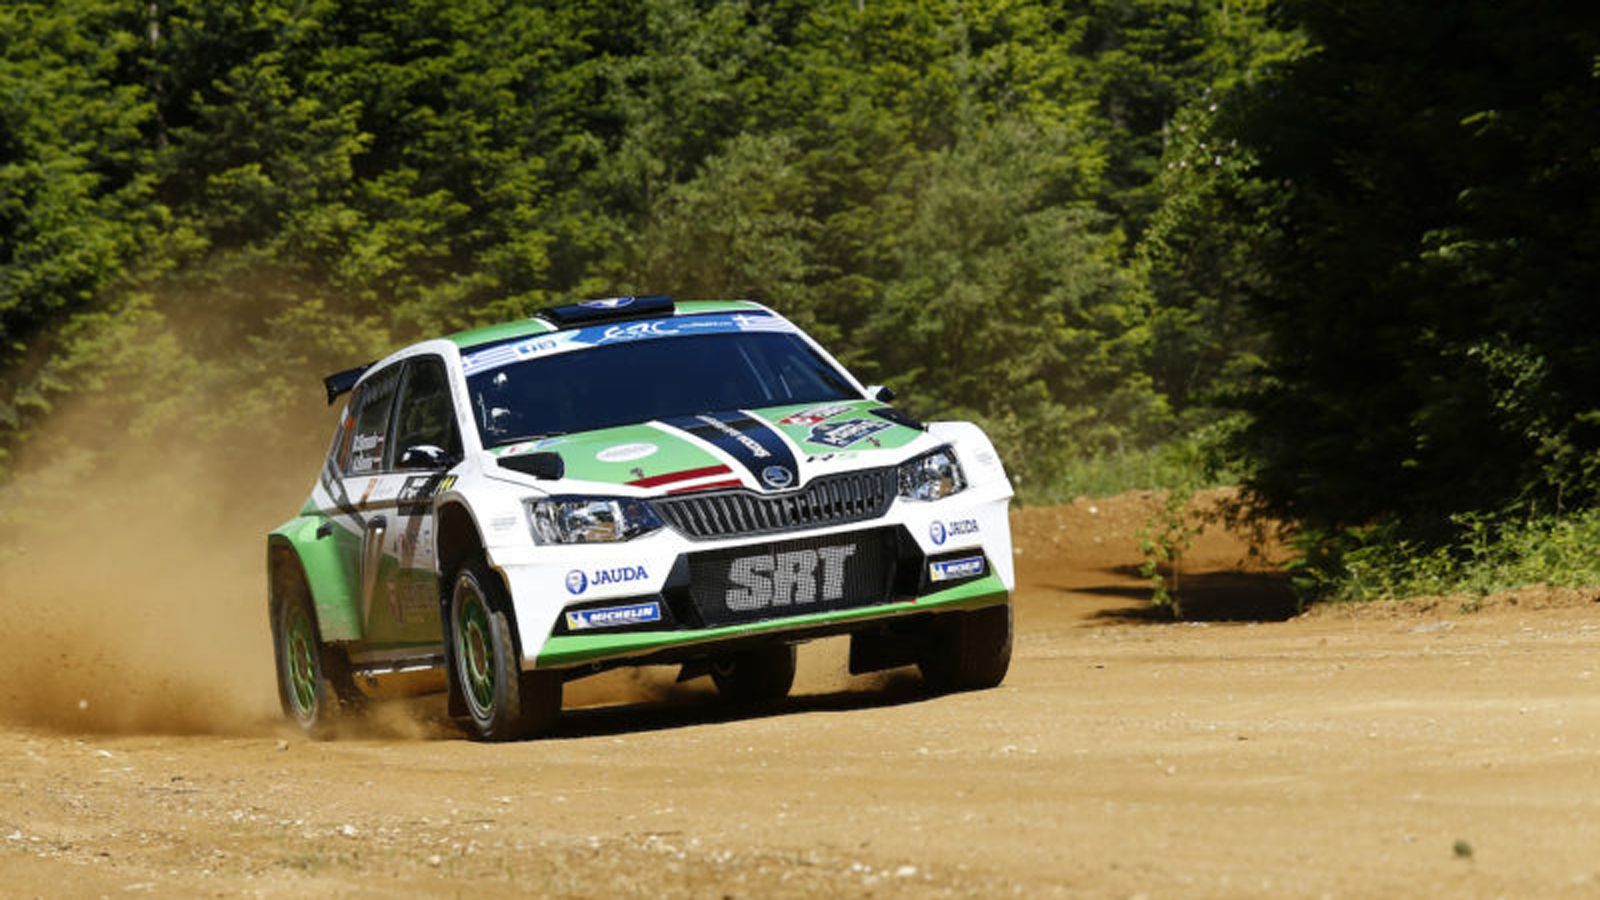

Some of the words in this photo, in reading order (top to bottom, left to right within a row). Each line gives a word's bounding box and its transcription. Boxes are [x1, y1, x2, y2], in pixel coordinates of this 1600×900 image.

[948, 519, 979, 537] JAUDA
[591, 565, 649, 586] JAUDA
[725, 543, 857, 612] SRT
[590, 606, 653, 622] MICHELIN
